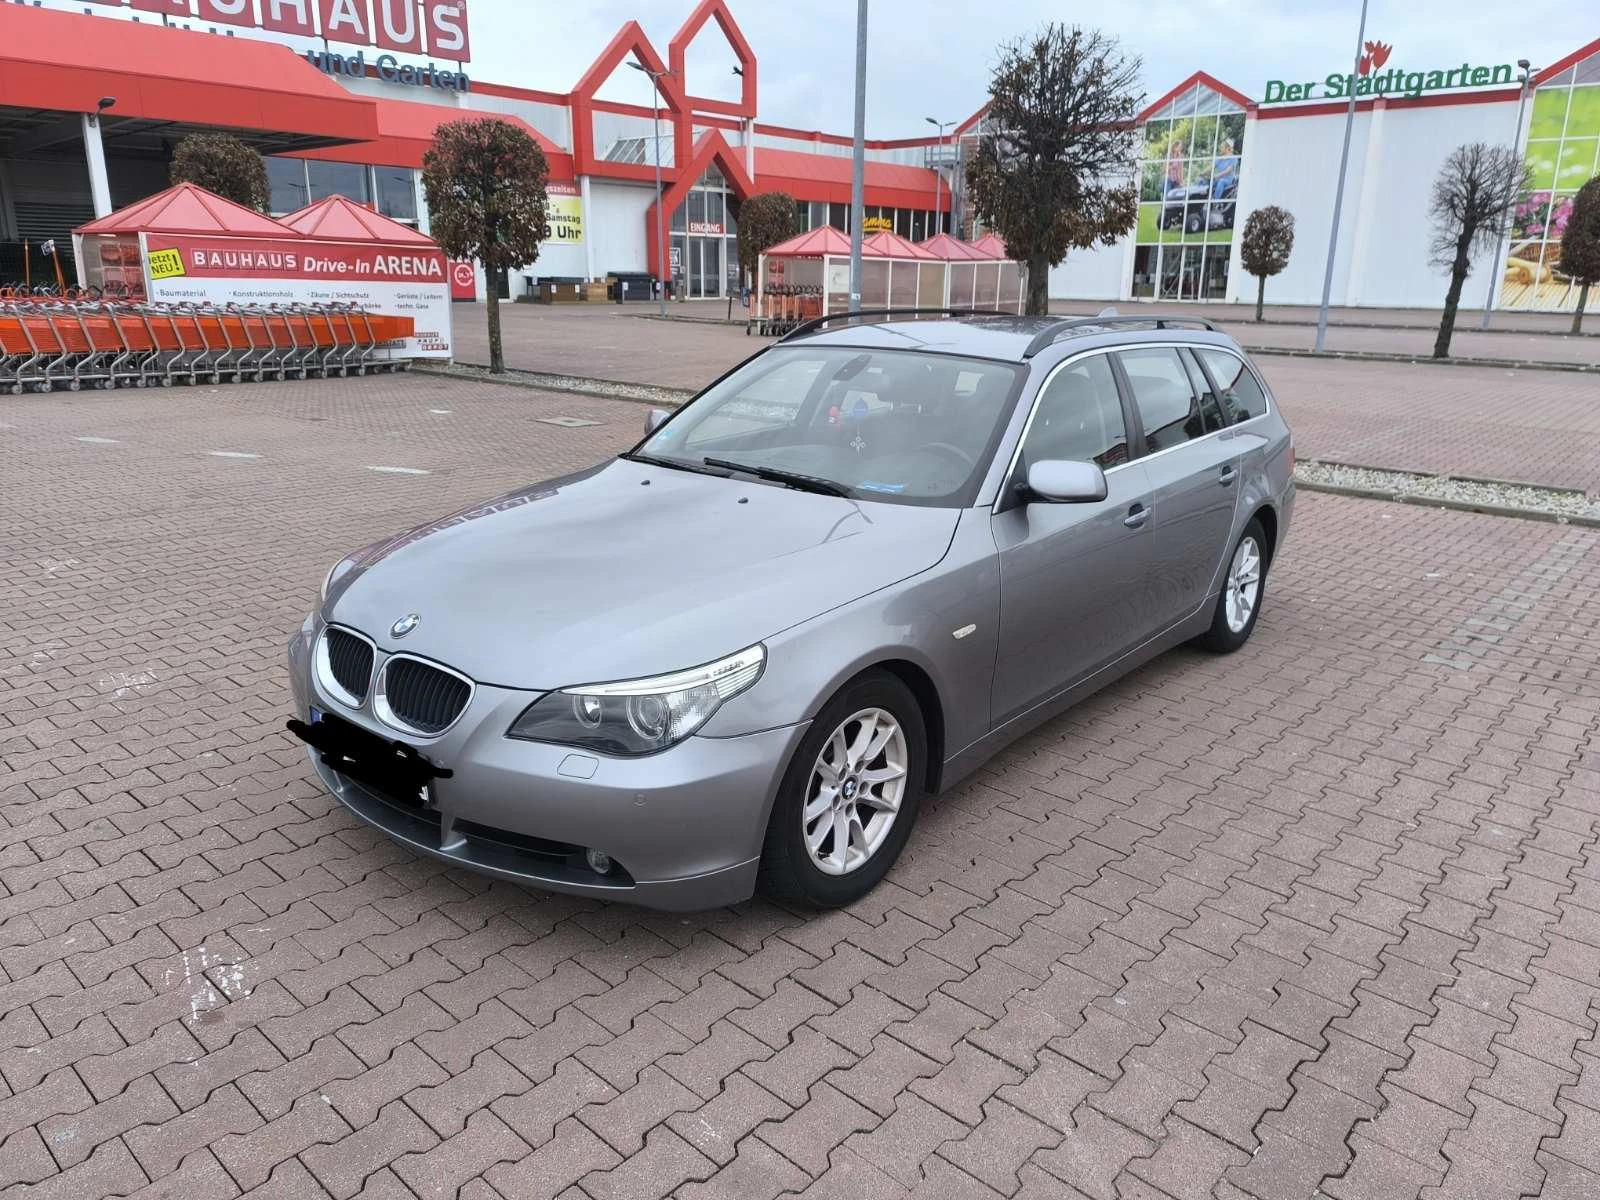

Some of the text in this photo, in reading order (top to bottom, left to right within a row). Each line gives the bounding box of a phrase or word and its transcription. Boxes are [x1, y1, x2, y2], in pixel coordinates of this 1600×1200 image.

[307, 50, 470, 92] und Garten
[1264, 63, 1512, 104] Der Stadtgarten
[545, 212, 581, 224] Samstag
[557, 225, 582, 239] Uhr
[690, 222, 720, 233] EINGANG
[193, 250, 297, 269] BAUHAUS
[303, 256, 370, 274] Drive-In
[373, 254, 442, 277] ARENA
[160, 288, 206, 297] Baumaterial
[232, 289, 294, 298] Konstruktionsholz
